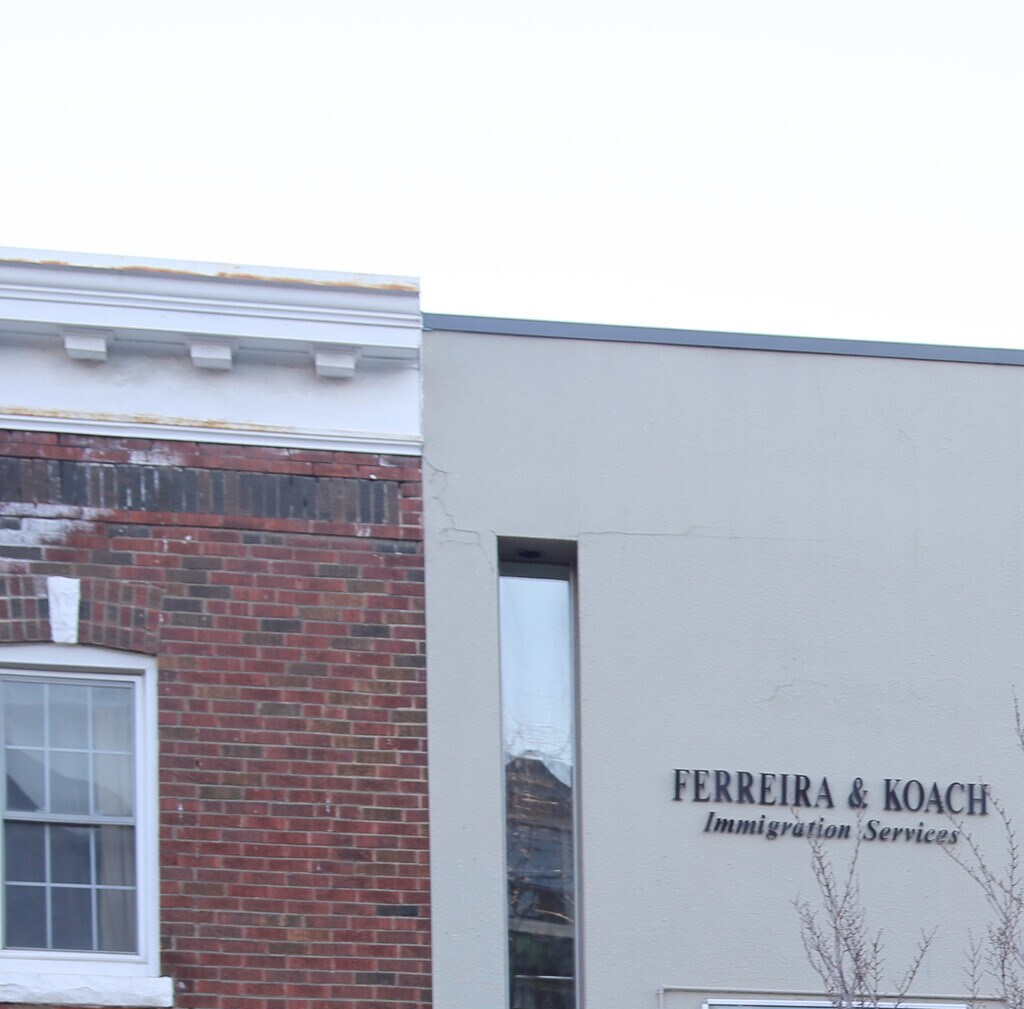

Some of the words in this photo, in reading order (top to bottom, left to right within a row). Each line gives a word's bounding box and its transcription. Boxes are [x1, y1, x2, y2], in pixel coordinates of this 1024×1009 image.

[671, 768, 835, 809] FERREIRA
[848, 777, 869, 810] &
[883, 778, 989, 816] KOACH
[703, 811, 851, 840] Immigration
[863, 818, 961, 845] Services
